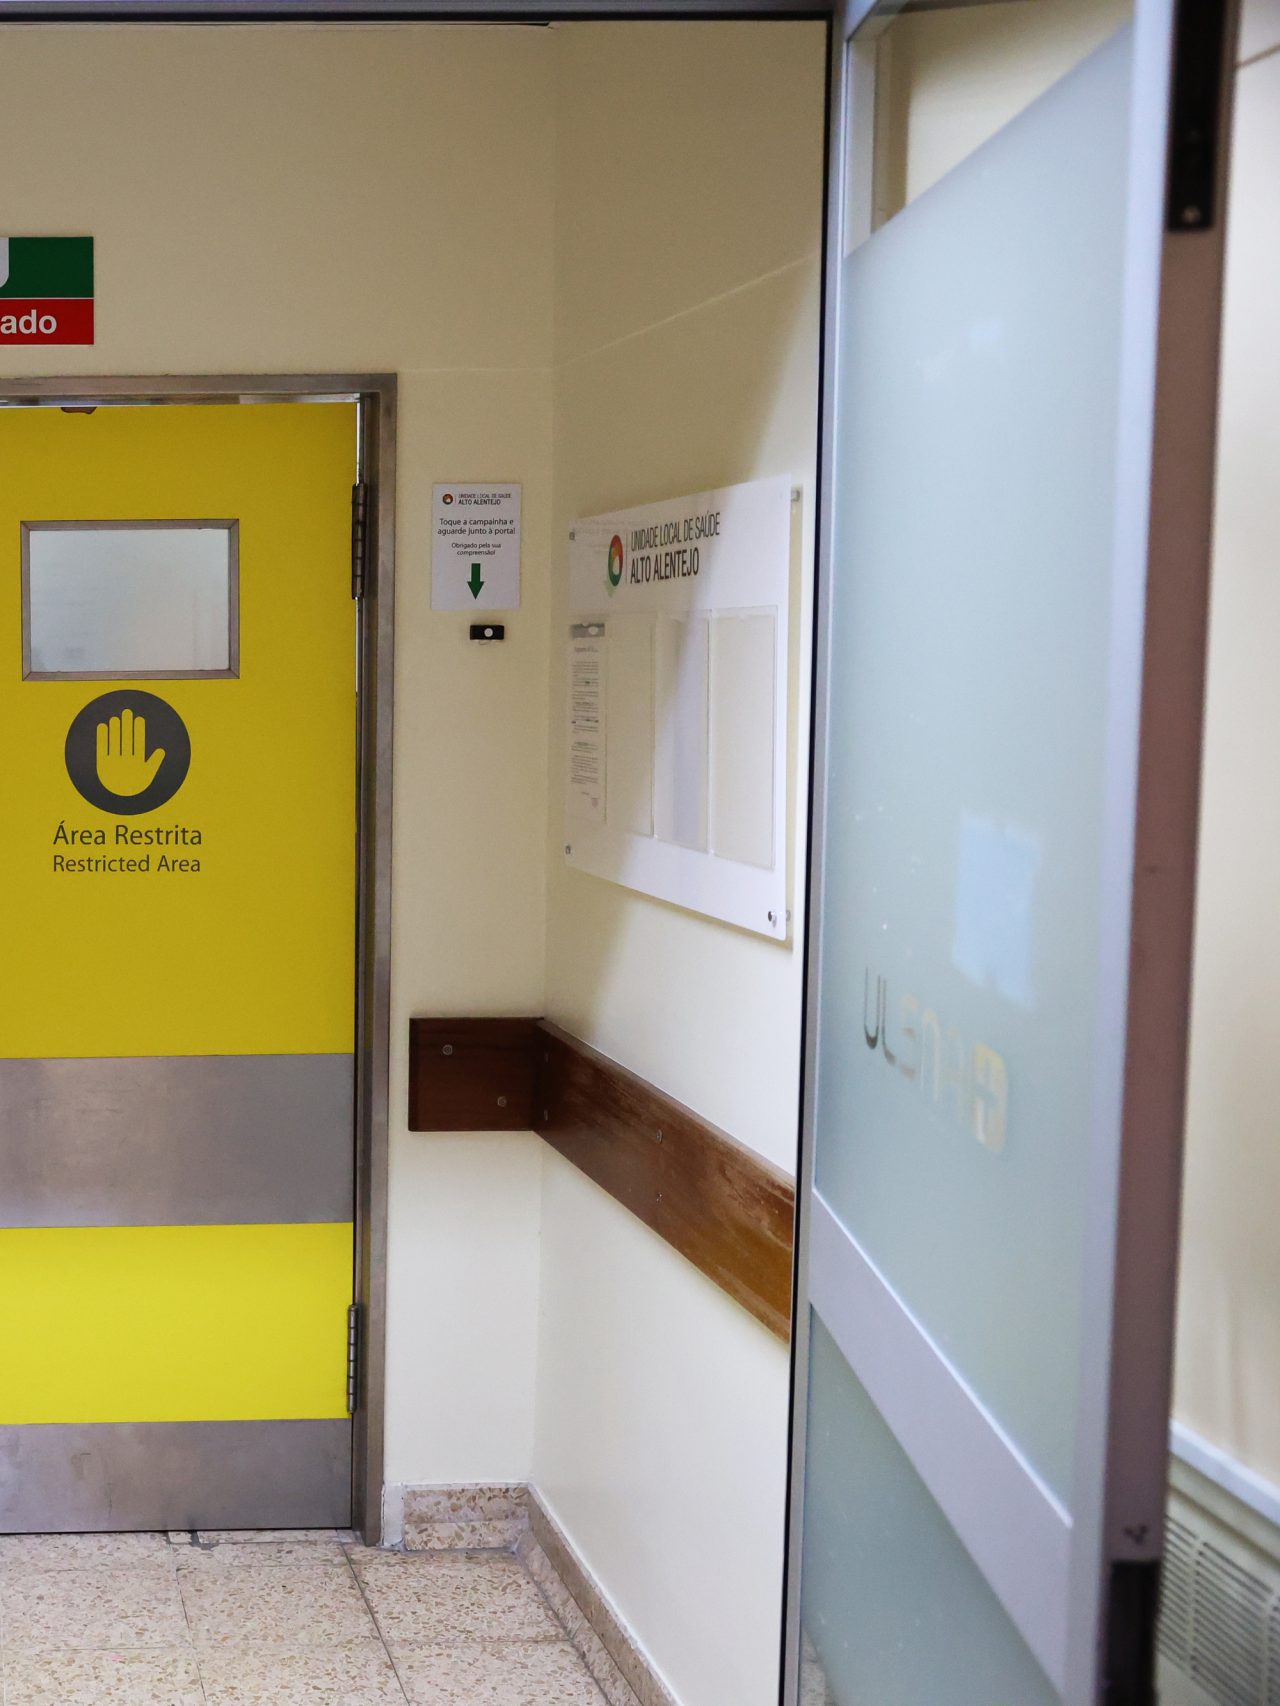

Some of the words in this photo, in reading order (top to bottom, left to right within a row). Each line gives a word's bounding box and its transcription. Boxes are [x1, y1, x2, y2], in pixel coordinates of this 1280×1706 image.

[437, 527, 467, 536] aguarde
[467, 527, 487, 536] junto
[439, 518, 461, 527] Toque
[468, 517, 508, 526] campainha
[631, 525, 659, 552] UNIDADE
[660, 521, 682, 547] LOCAL
[683, 518, 694, 542] DE
[695, 510, 720, 540] SAÚDE
[451, 542, 478, 550] Obrigado
[630, 555, 651, 584] ALTO
[653, 547, 700, 582] ALENTEJO
[52, 819, 106, 846] Área
[115, 824, 202, 846] Restrita
[53, 853, 150, 873] Restricted
[157, 854, 201, 873] Area
